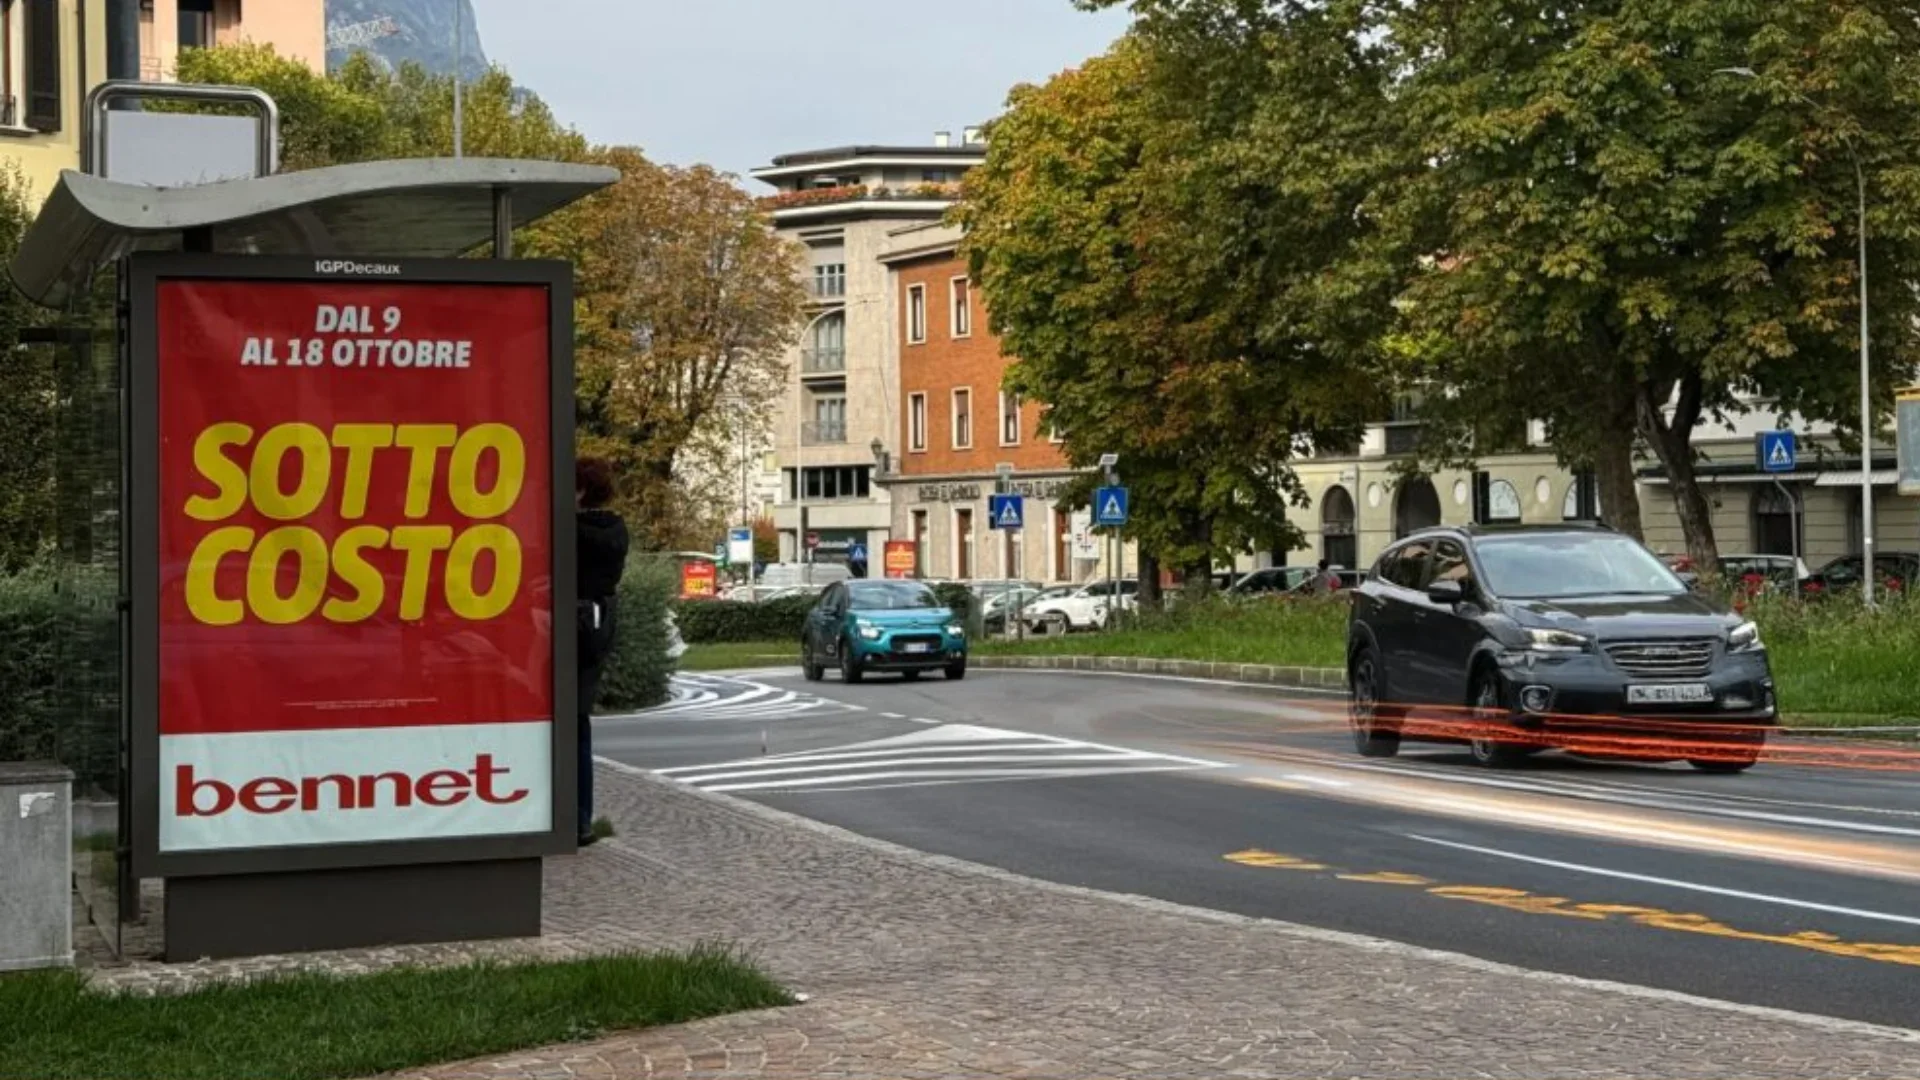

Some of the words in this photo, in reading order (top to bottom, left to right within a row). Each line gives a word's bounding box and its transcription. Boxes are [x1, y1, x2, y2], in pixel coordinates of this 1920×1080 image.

[315, 259, 400, 274] IGPDecaux
[315, 304, 374, 333] DAL
[382, 305, 401, 333] 9
[240, 337, 278, 366] AL
[286, 338, 324, 366] 18
[331, 338, 472, 367] OTTOBRE
[184, 422, 526, 520] SOTTO
[185, 524, 522, 626] COSTO
[175, 753, 529, 817] bennet
